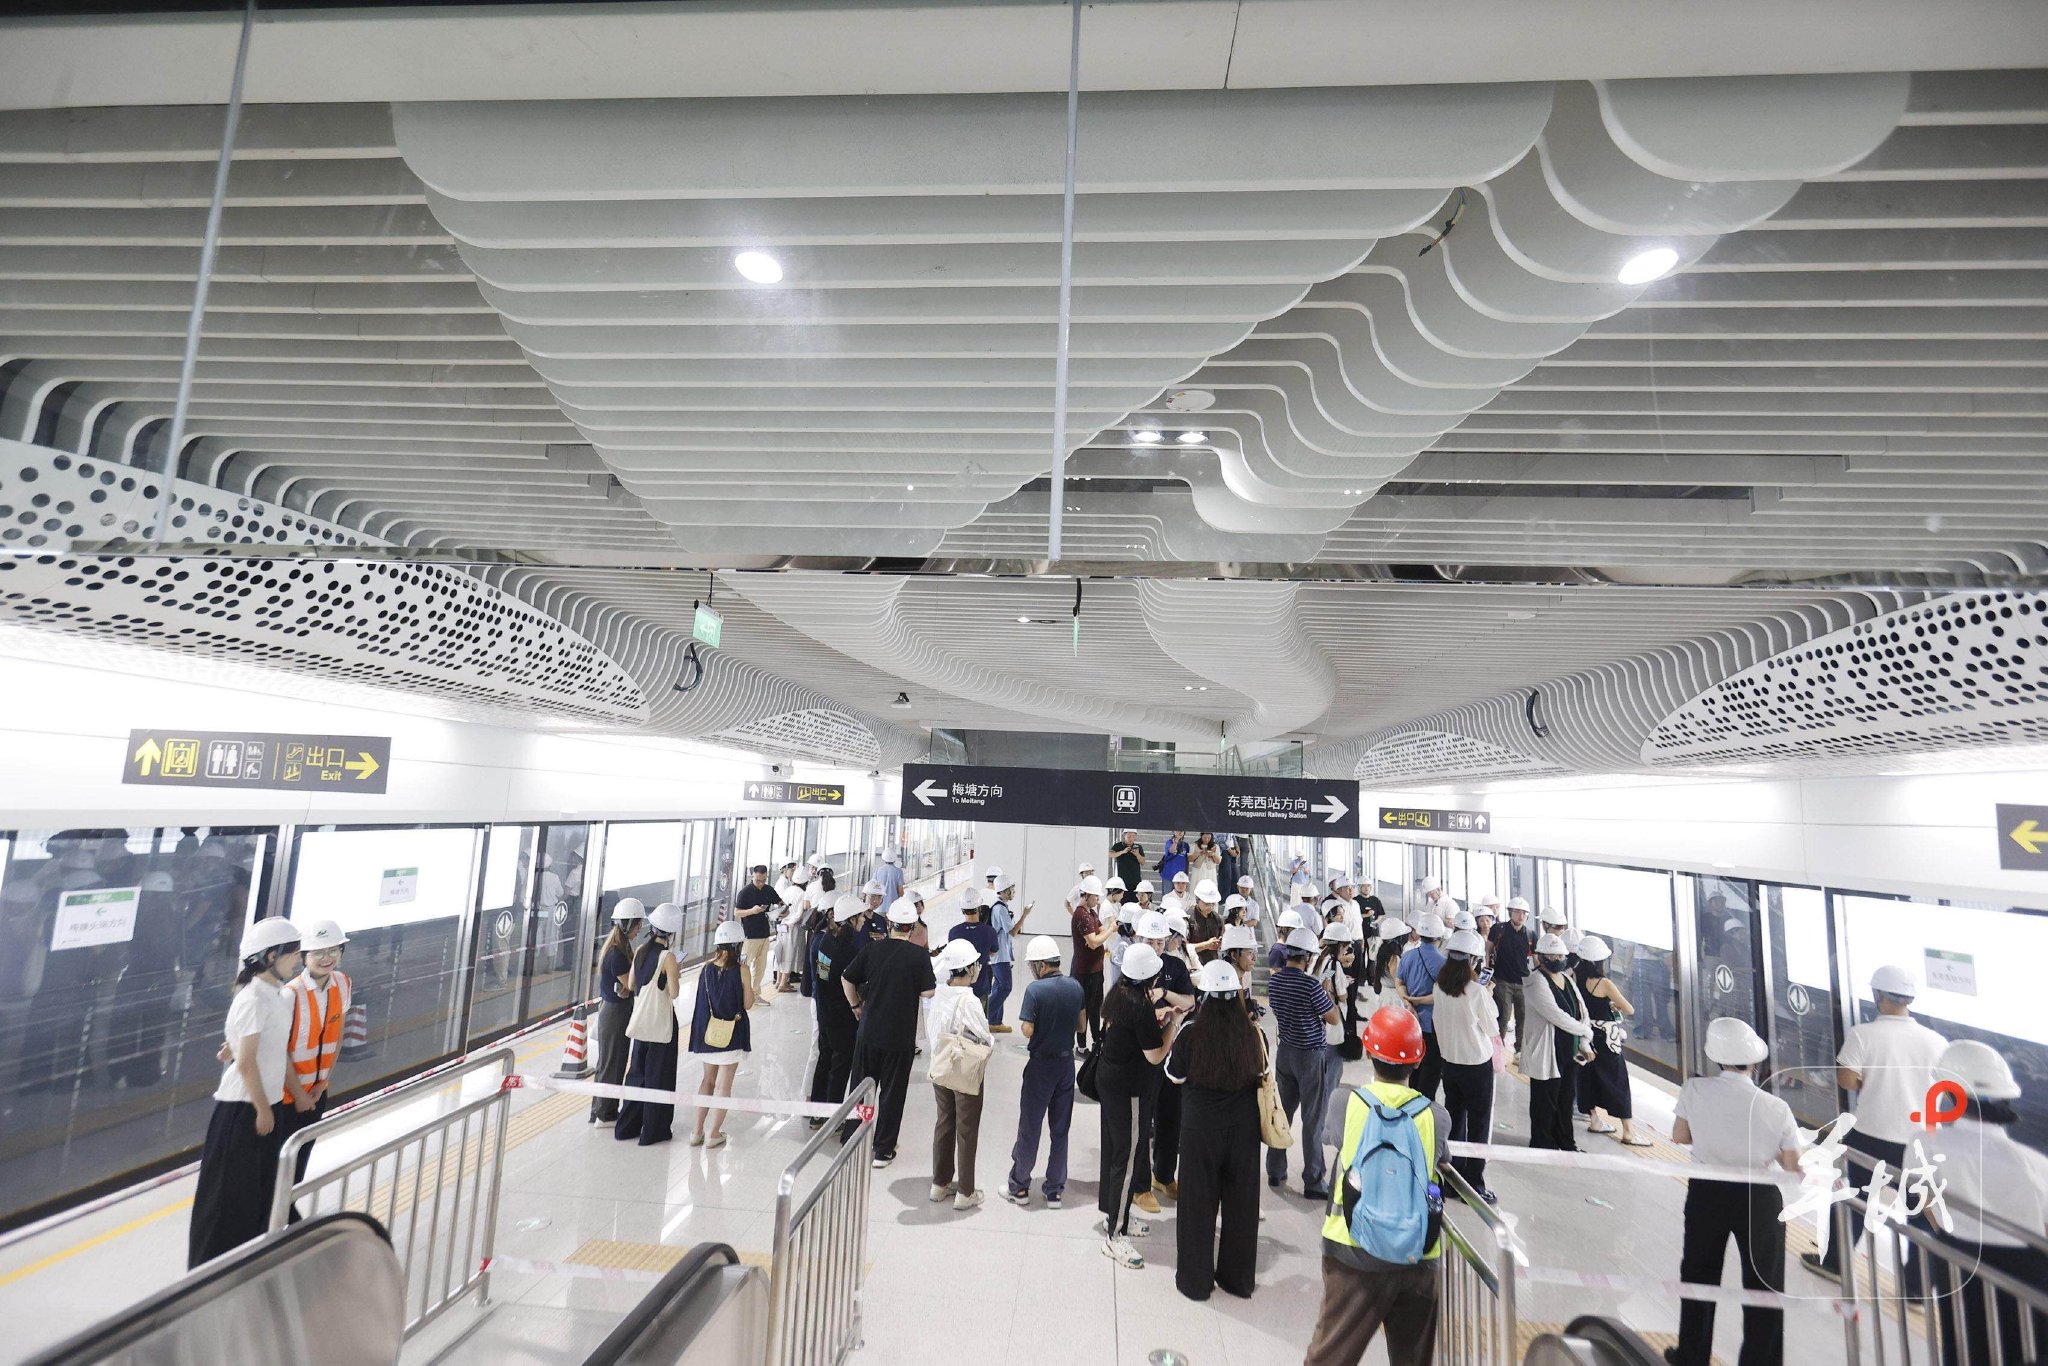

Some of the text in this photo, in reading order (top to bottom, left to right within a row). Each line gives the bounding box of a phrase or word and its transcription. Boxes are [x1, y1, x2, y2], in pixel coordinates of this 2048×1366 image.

[306, 746, 345, 767] 出口
[320, 770, 342, 781] Exit
[812, 788, 828, 796] 出口
[951, 783, 1003, 797] 梅塘方向
[1227, 794, 1308, 811] 东莞西站方向
[1236, 810, 1267, 818] Dongguanxi
[1267, 811, 1288, 820] Railway
[1398, 812, 1415, 821] 出口
